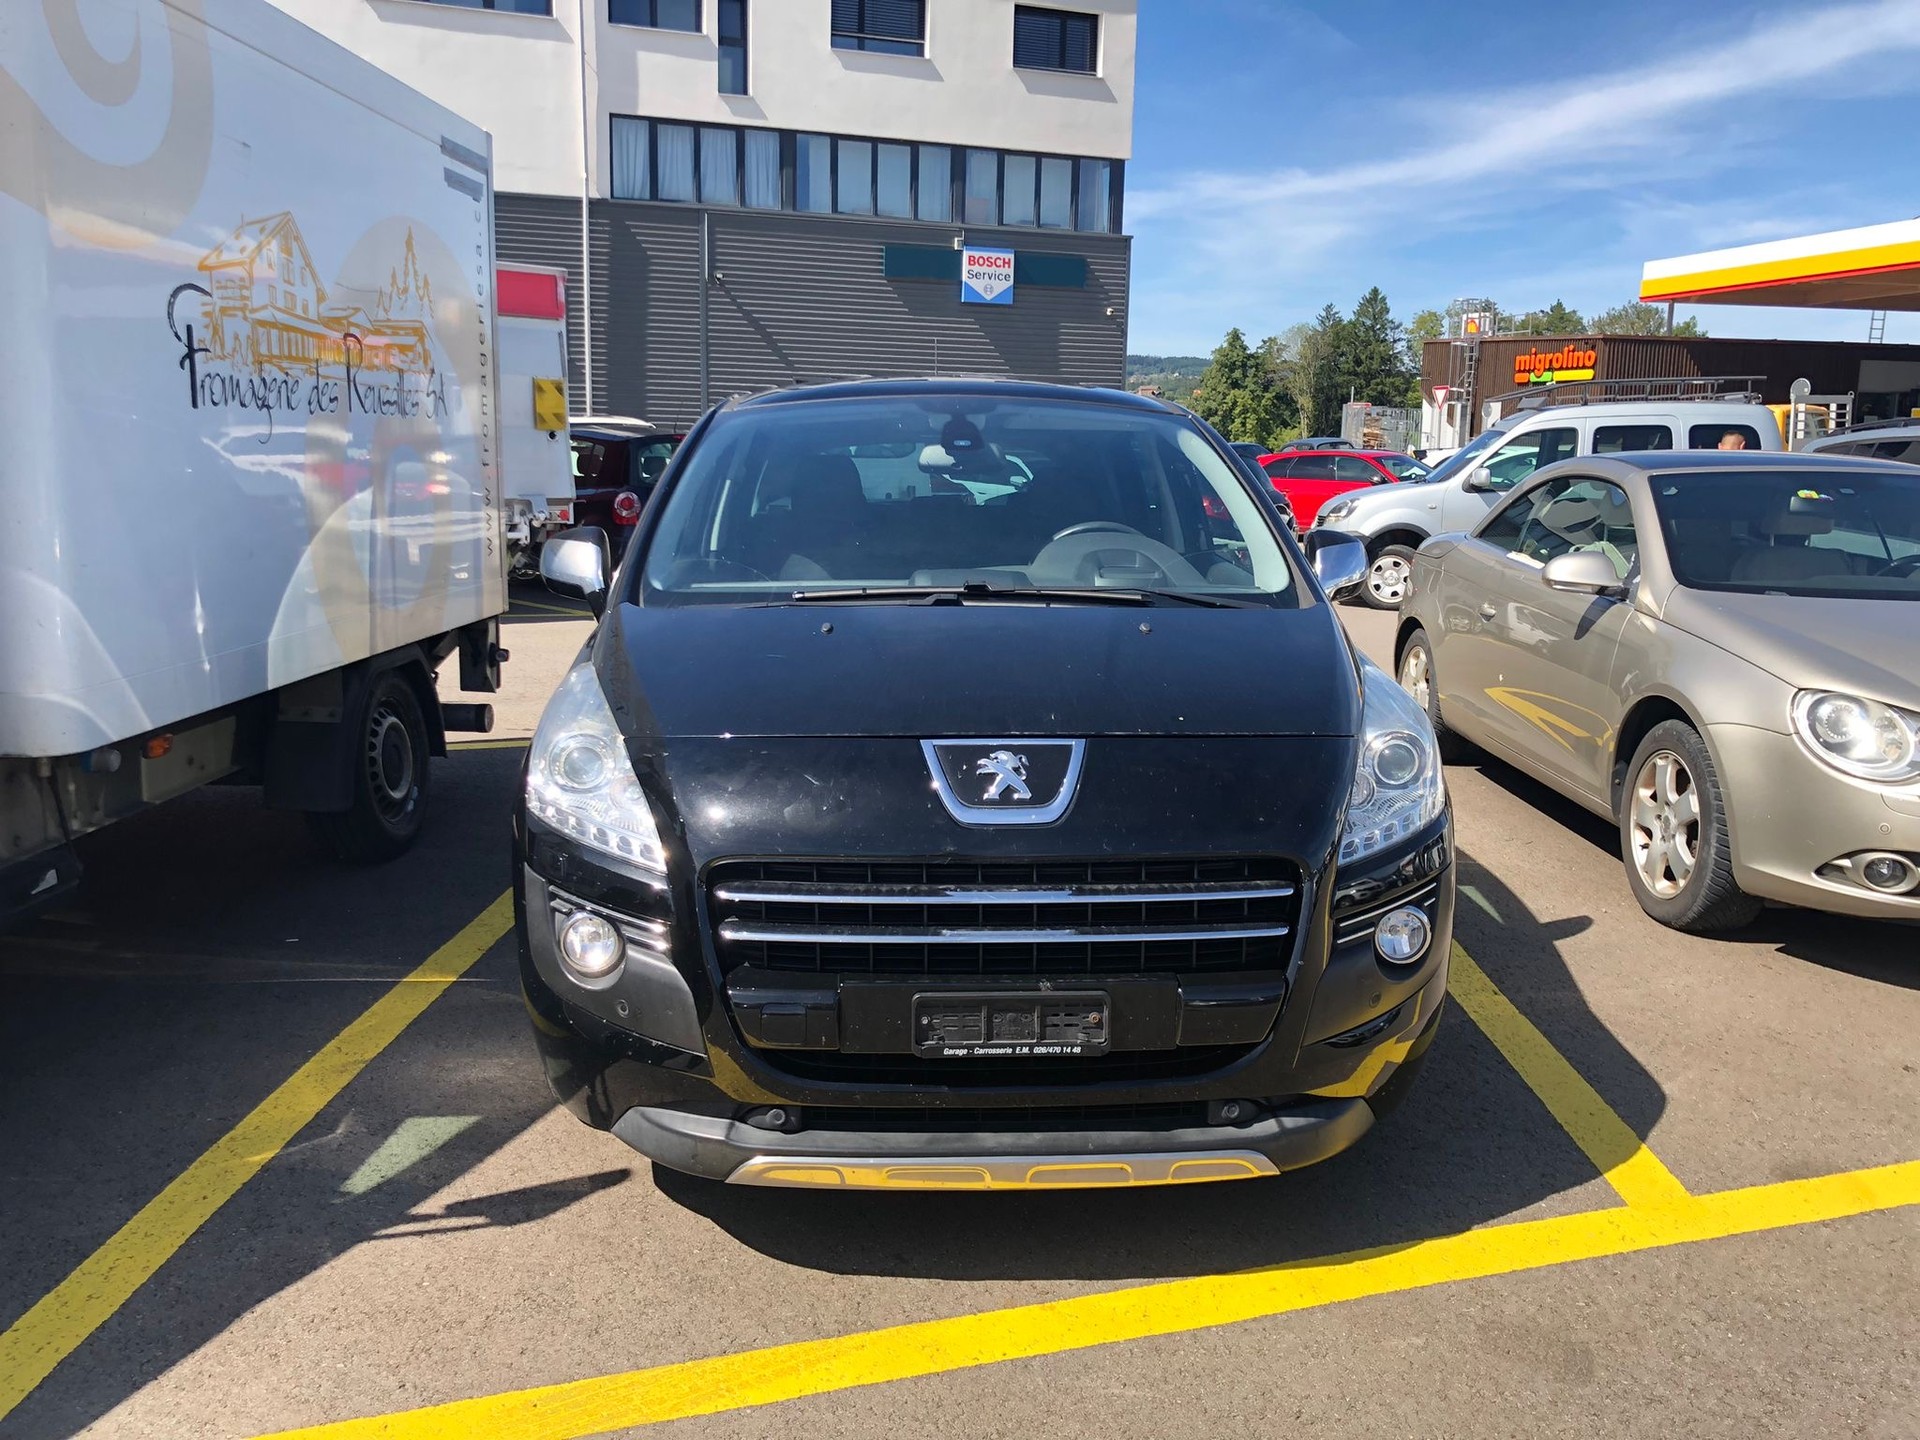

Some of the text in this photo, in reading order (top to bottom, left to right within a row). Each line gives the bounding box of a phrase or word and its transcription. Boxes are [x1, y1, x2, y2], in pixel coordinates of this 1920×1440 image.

[968, 255, 1011, 268] BOSCH
[967, 269, 1011, 281] Service
[167, 283, 301, 444] Fromagerie
[307, 358, 339, 417] des
[425, 362, 449, 419] SA
[1515, 344, 1596, 377] migrolino
[474, 197, 494, 558] www.fromageriesa.c
[943, 1047, 968, 1056] Garage
[974, 1046, 1013, 1054] Carrosserie
[1015, 1046, 1030, 1054] E.M.
[1033, 1046, 1062, 1054] 026/470
[1062, 1046, 1072, 1054] 14
